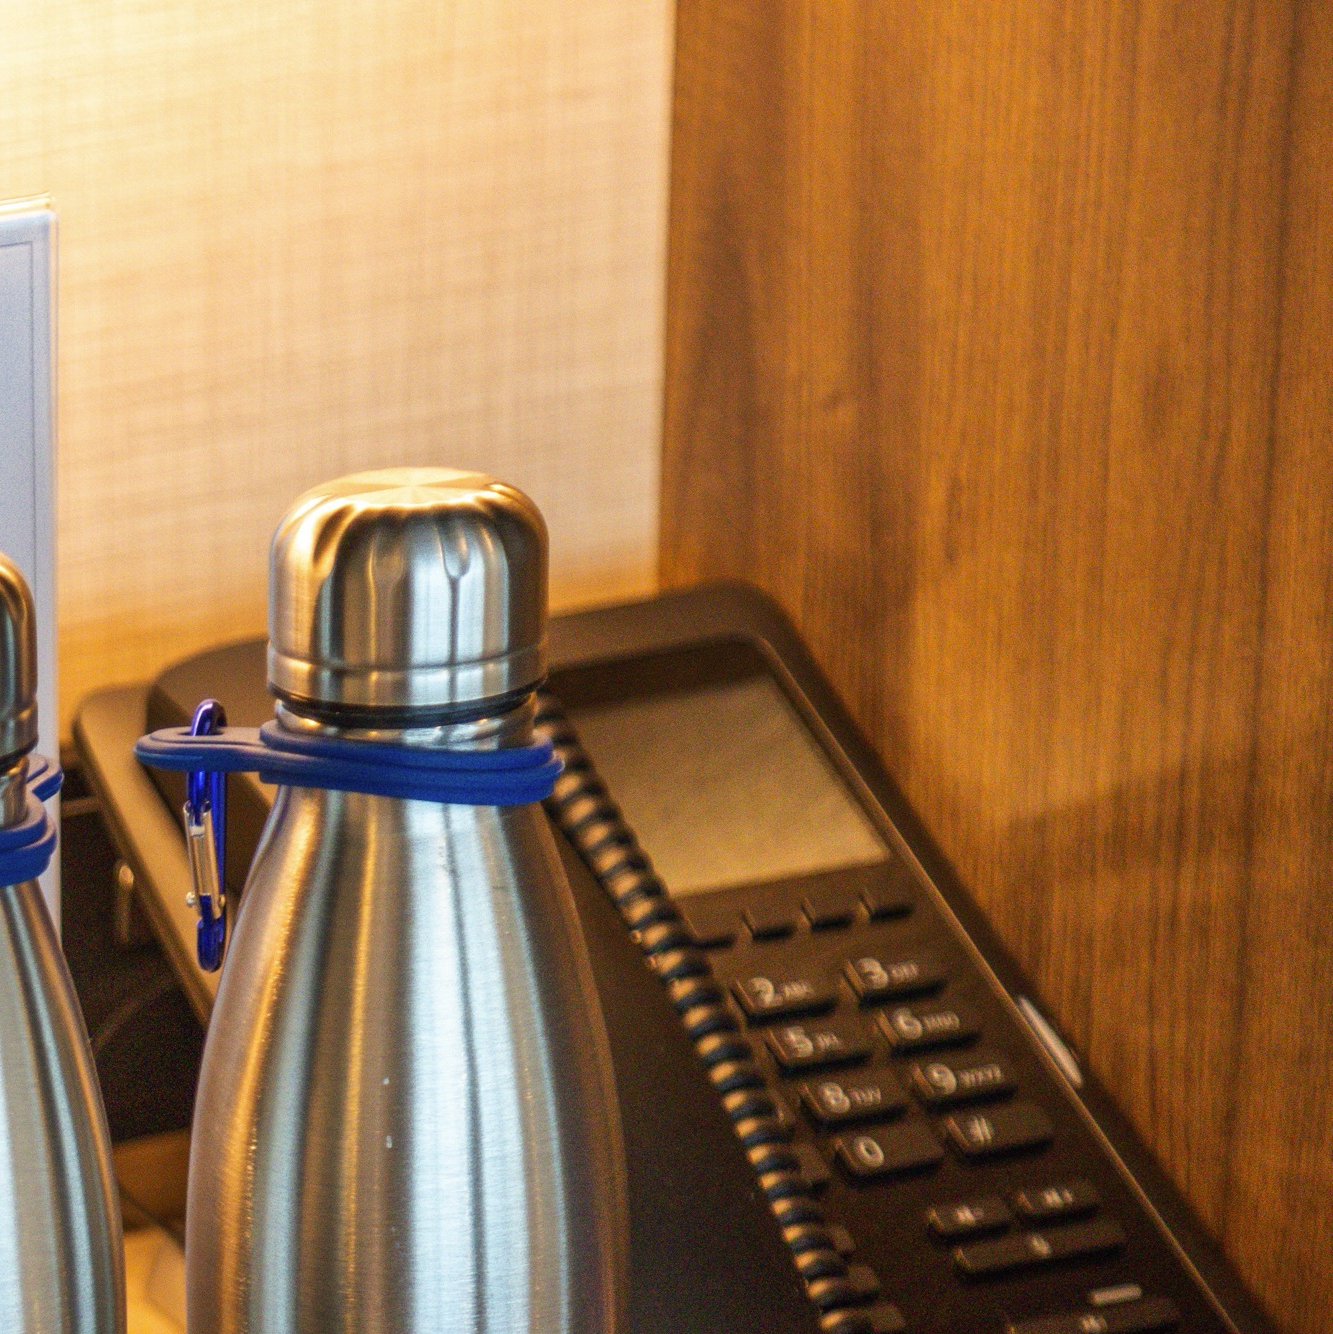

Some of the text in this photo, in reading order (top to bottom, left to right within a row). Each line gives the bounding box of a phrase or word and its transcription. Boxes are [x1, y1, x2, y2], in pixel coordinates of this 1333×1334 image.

[856, 957, 889, 990] 3
[892, 1007, 923, 1040] 6
[925, 1062, 957, 1097] 9
[852, 1136, 884, 1168] 0
